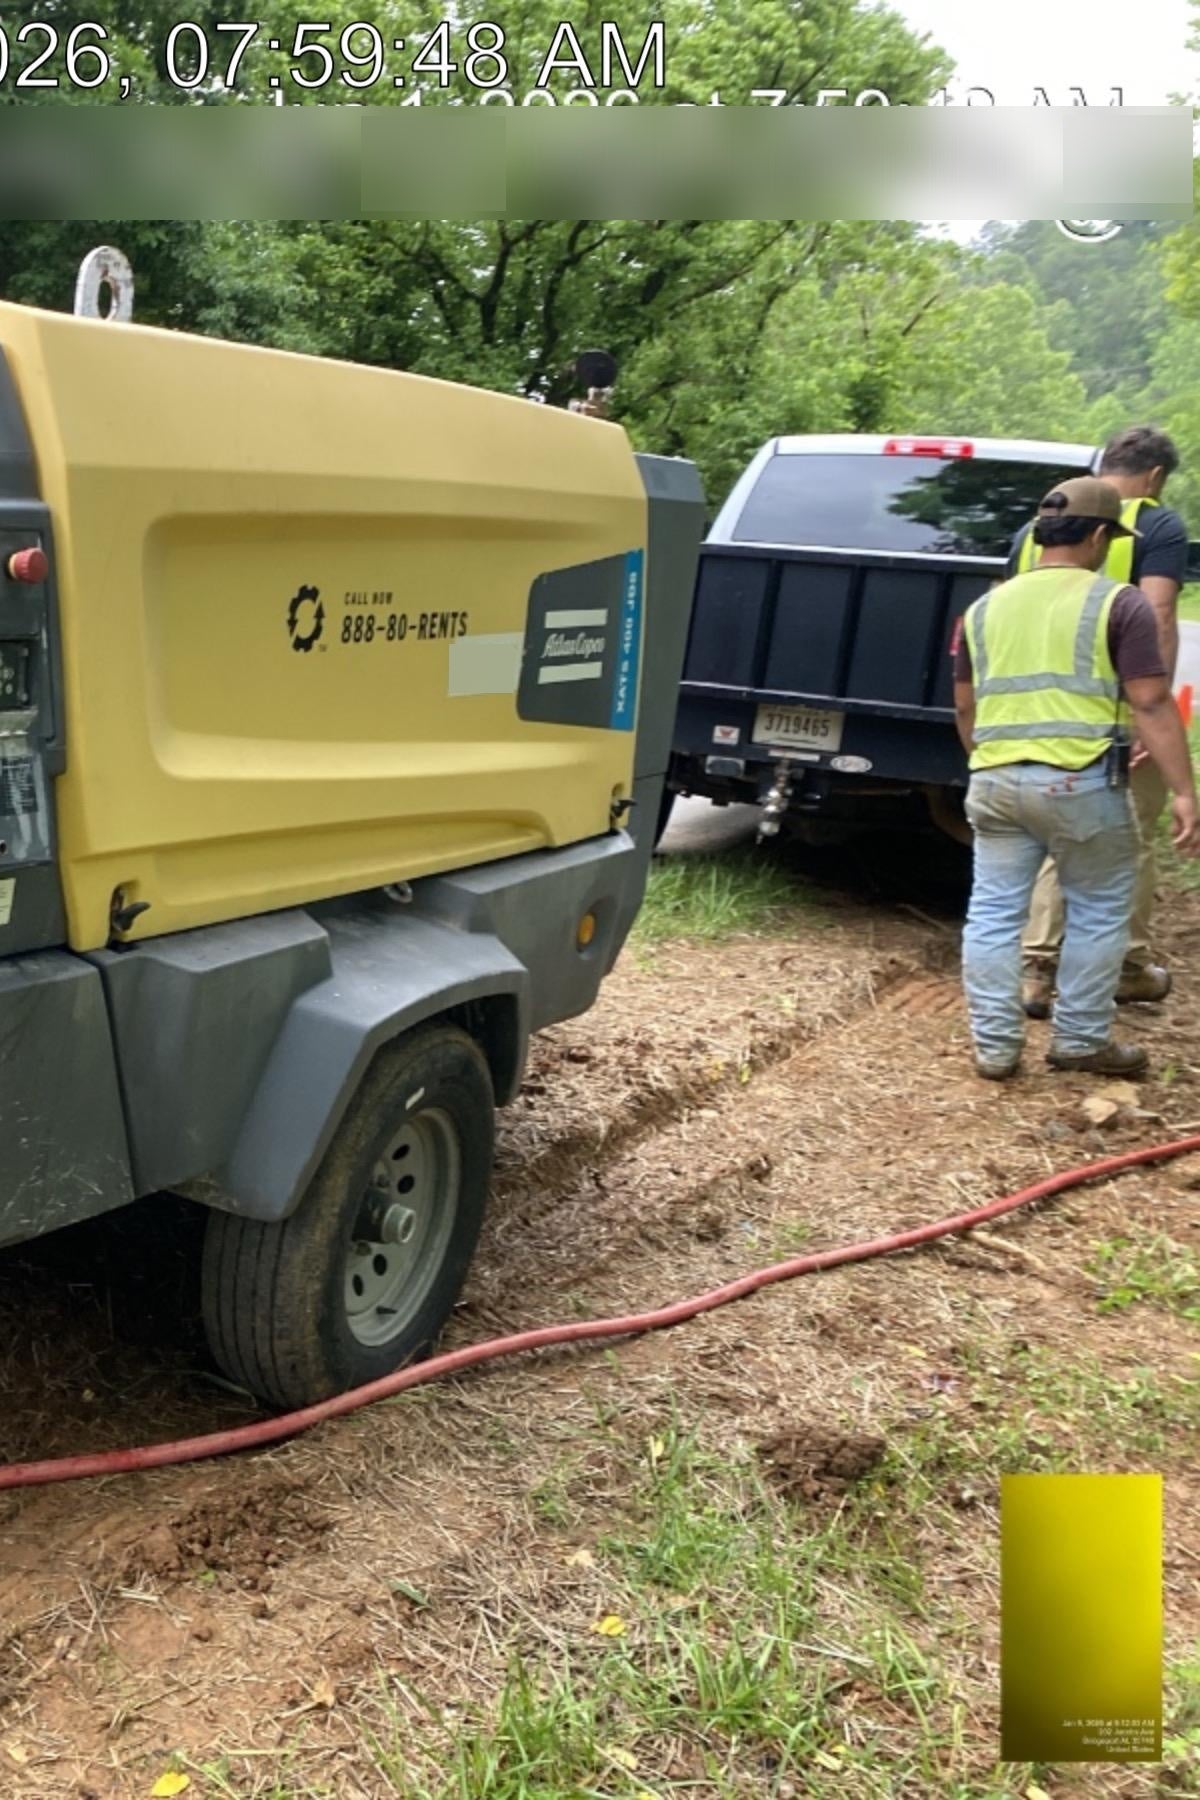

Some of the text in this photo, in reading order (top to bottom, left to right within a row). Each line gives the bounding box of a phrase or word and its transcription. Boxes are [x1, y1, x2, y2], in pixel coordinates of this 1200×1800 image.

[344, 592, 393, 605] CALL NOW
[341, 612, 468, 643] 888-80-RENTS
[764, 712, 832, 738] 3719465
